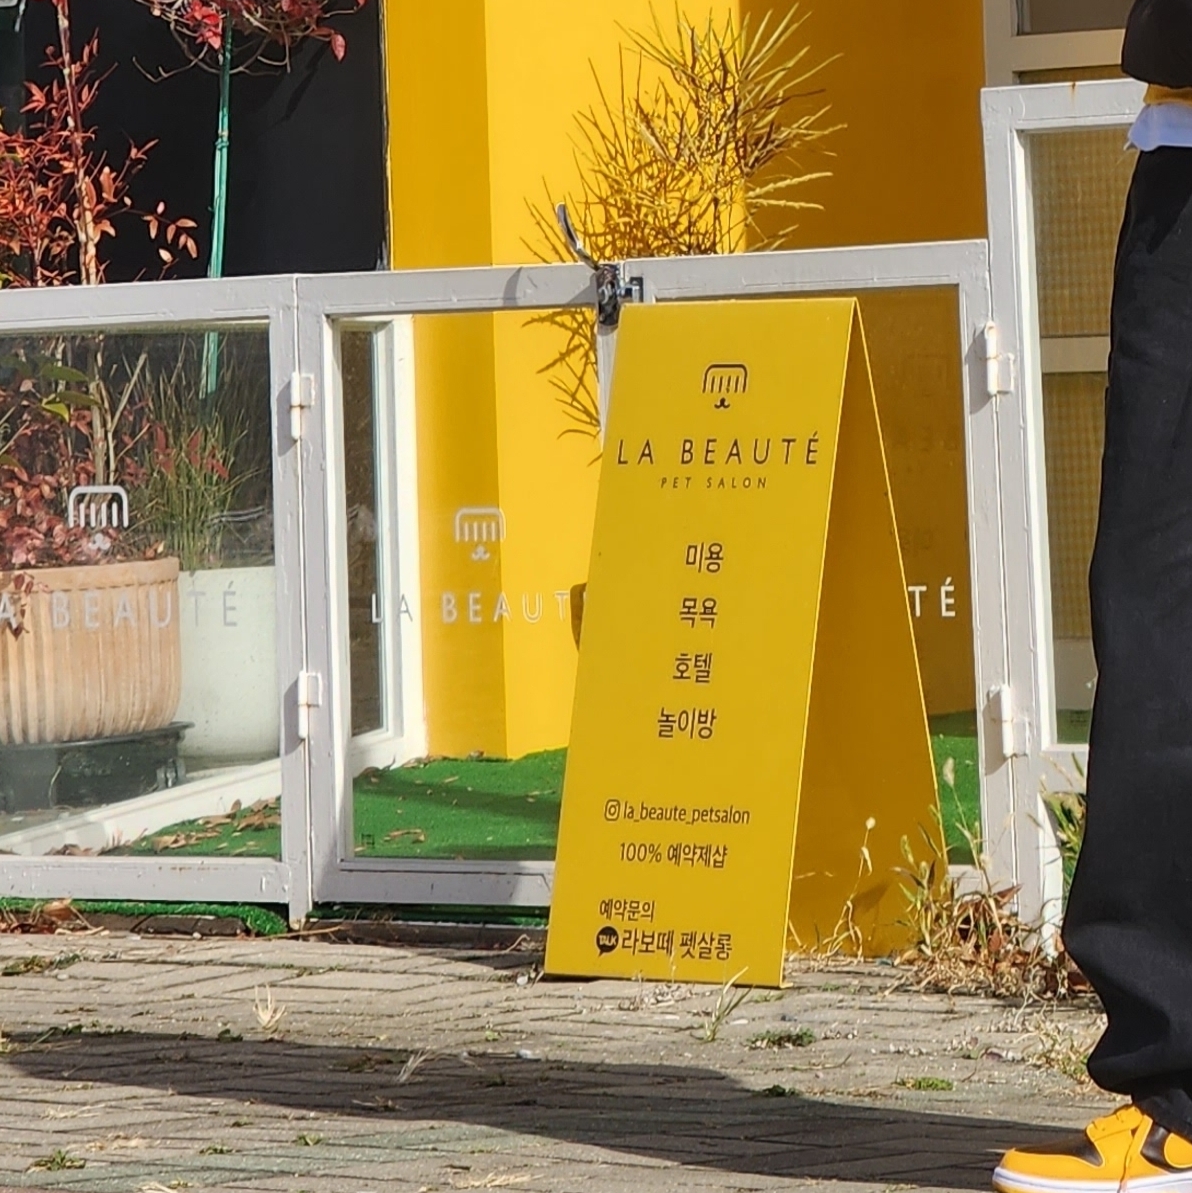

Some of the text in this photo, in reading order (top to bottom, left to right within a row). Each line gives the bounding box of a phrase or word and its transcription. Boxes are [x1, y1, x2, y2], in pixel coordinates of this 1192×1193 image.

[617, 431, 820, 465] LA BEAUTÉ
[660, 476, 768, 490] PET SALON
[685, 542, 724, 574] 미용
[52, 584, 238, 630] BEAUTÉ
[371, 590, 588, 625] LA BEAUT
[679, 596, 718, 628] 목욕
[907, 577, 956, 618] TÉ
[673, 652, 713, 684] 호텔
[657, 708, 717, 740] 놀이방
[623, 800, 750, 826] la_beaute_petsalon
[620, 842, 728, 869] 100% 예약제샵
[599, 898, 656, 923] 예약문의
[622, 928, 674, 957] 라보떼
[679, 930, 733, 961] 펫살롱
